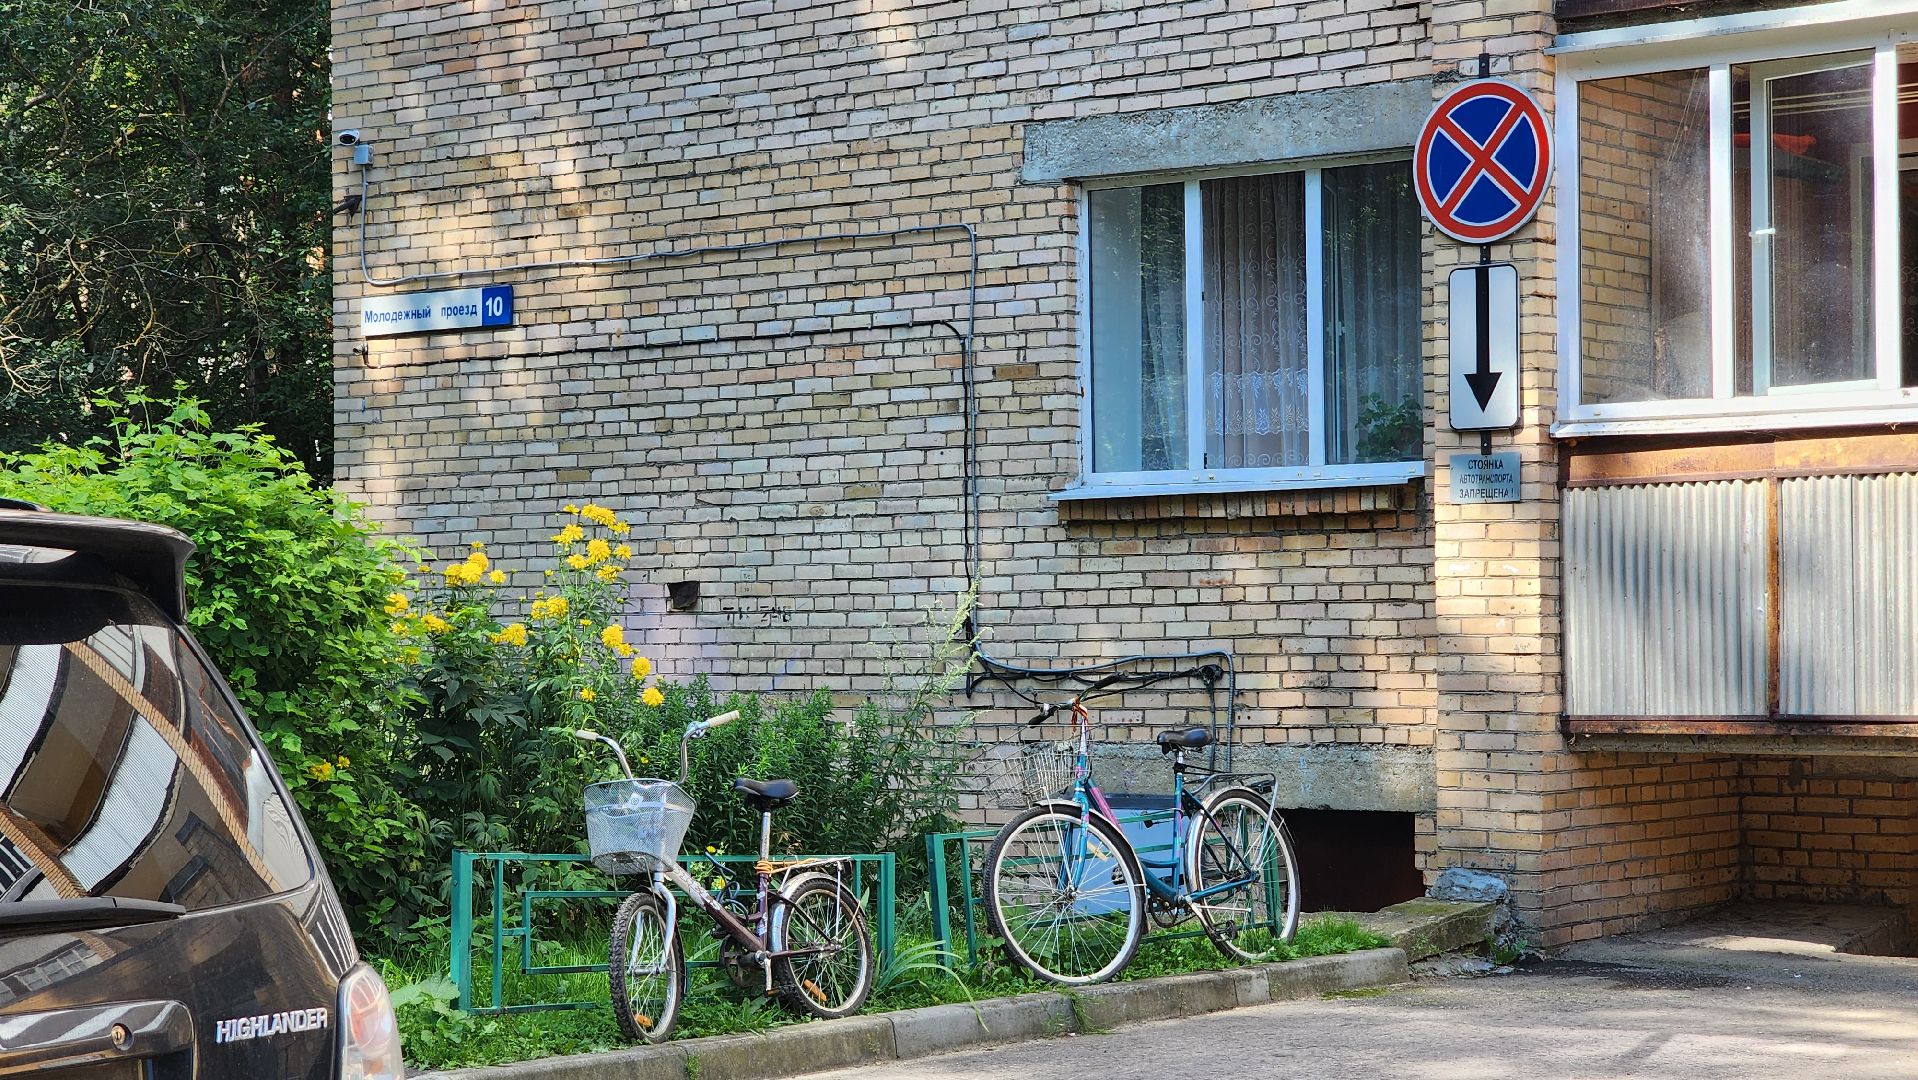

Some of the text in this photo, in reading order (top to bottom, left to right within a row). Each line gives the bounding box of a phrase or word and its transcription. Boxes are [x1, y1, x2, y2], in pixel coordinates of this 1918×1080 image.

[364, 296, 503, 323] Молодежный проезд 10
[1467, 459, 1504, 470] СТОЯНКА
[1459, 473, 1514, 484] АВТОТРАНСПОРТА
[215, 1007, 328, 1044] HIGHLANDER
